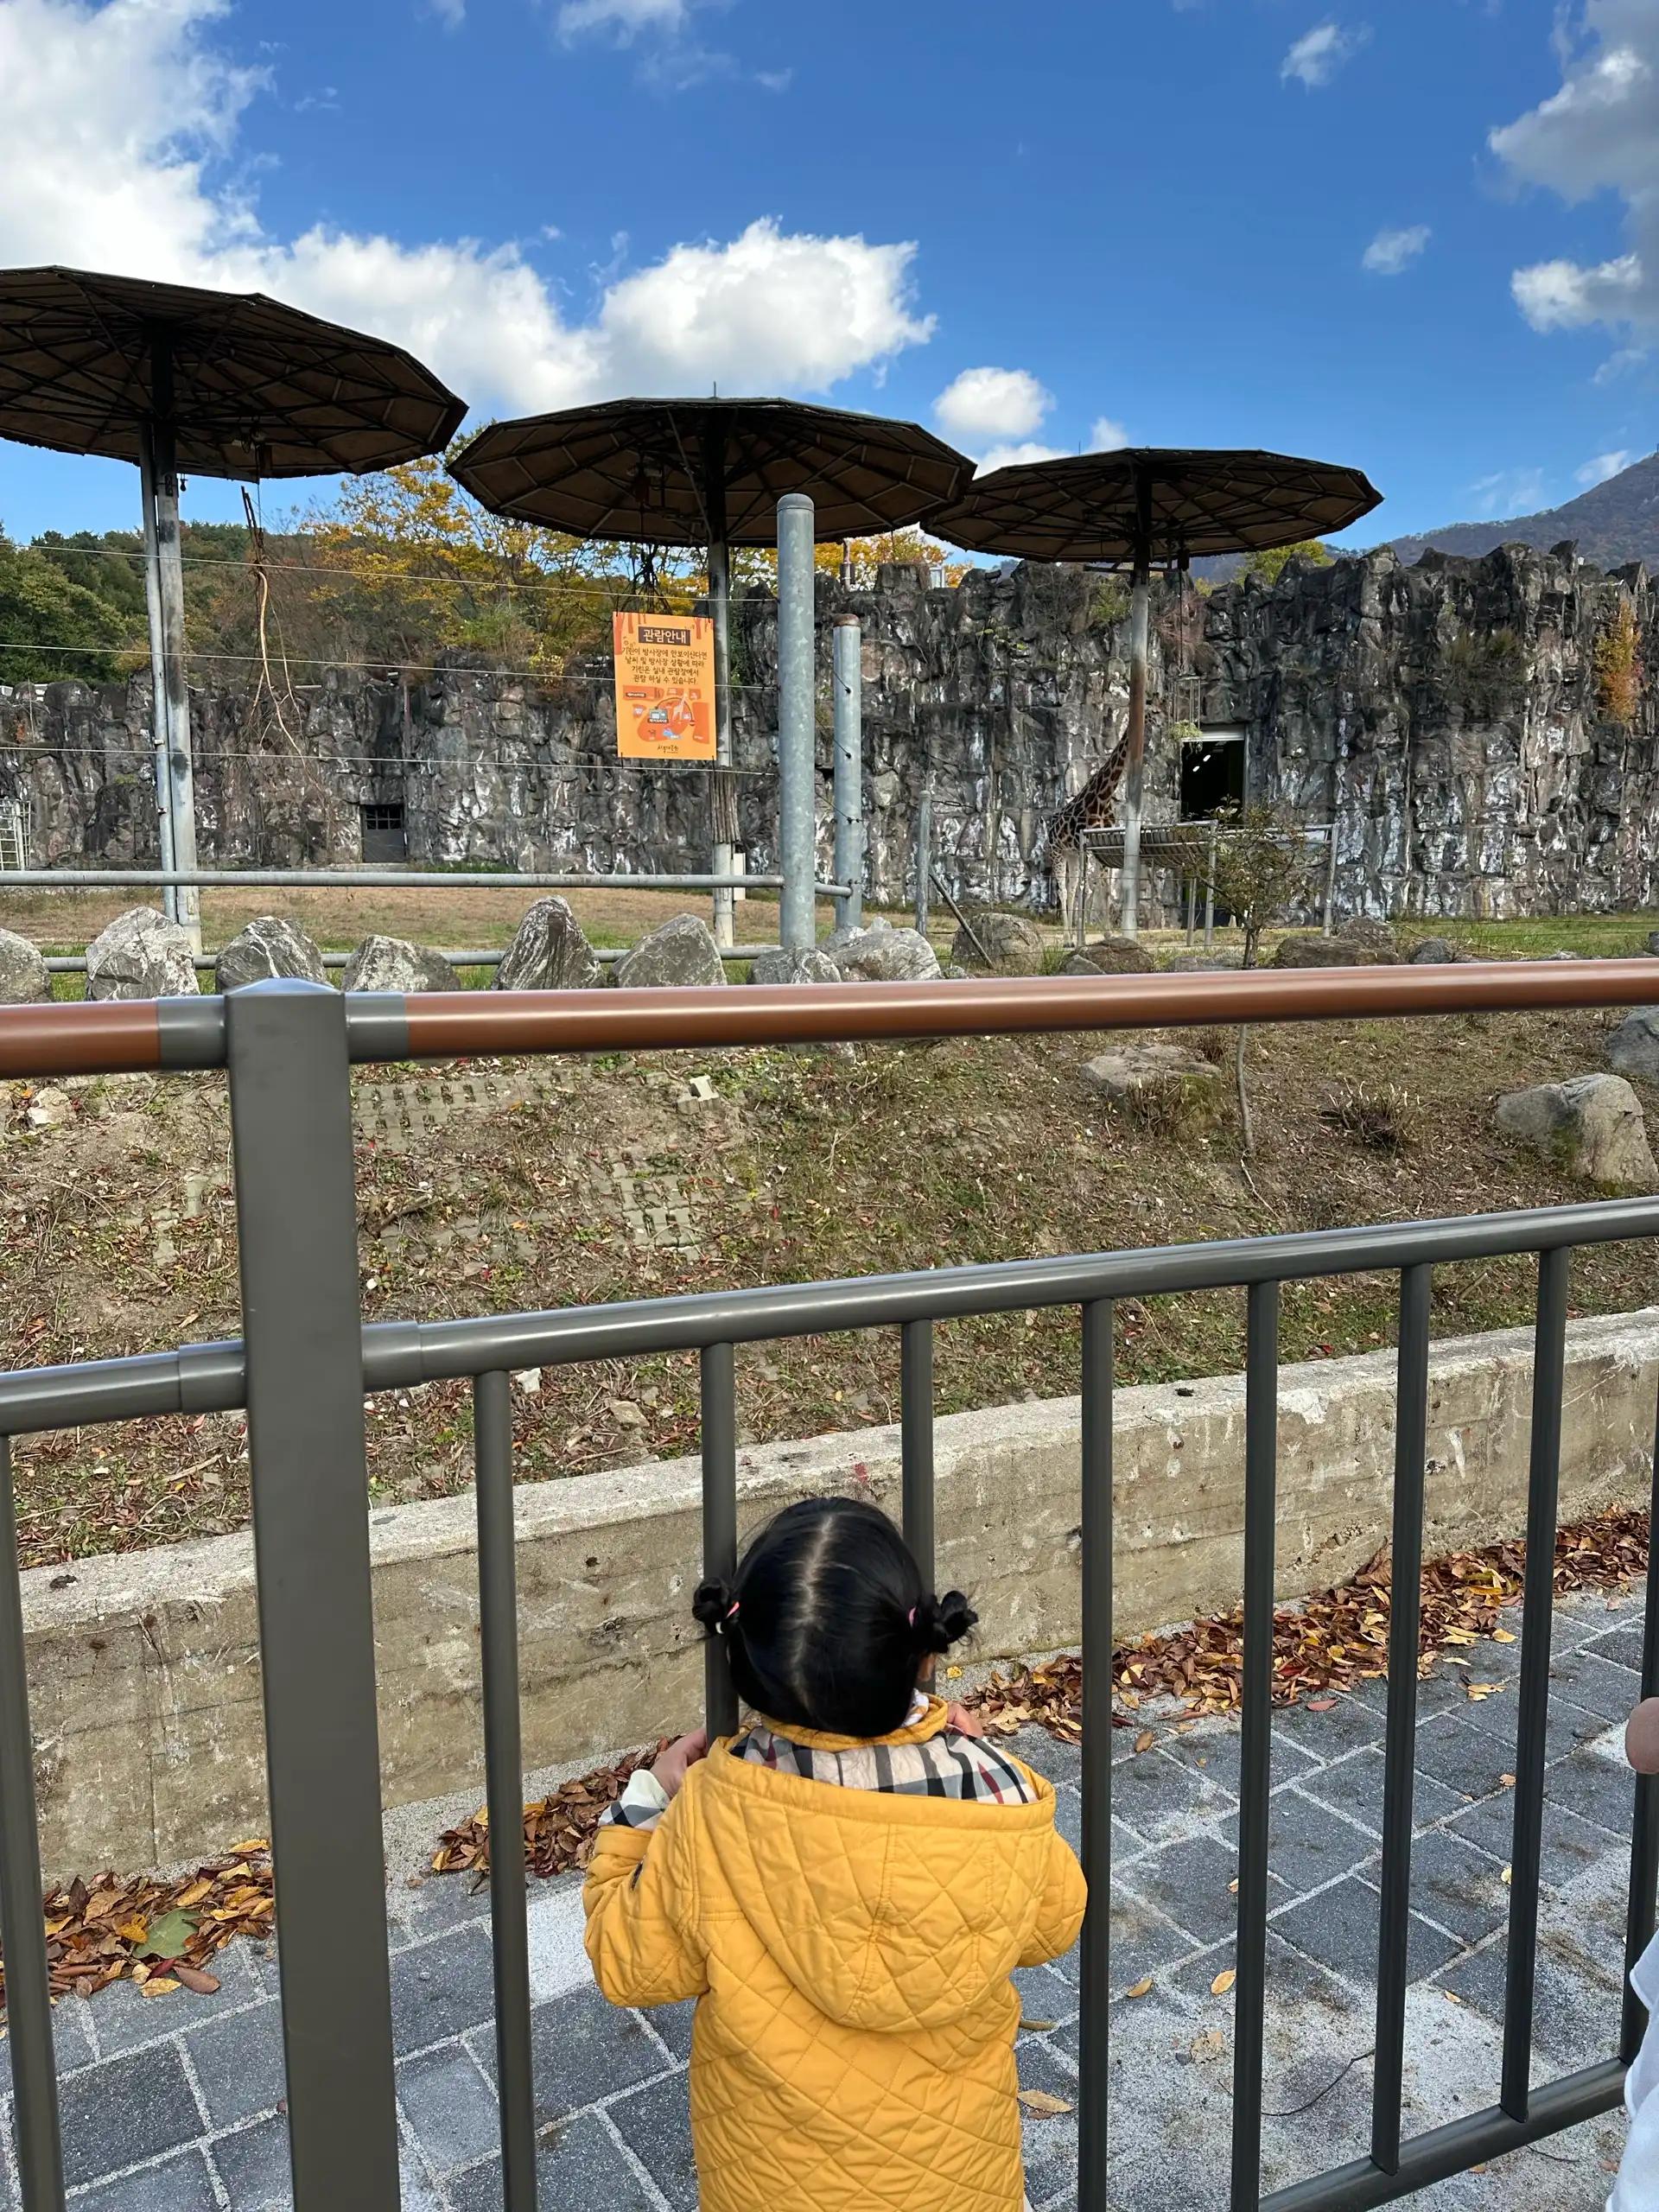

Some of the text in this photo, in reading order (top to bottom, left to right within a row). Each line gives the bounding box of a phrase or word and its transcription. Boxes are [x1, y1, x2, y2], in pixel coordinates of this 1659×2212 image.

[643, 630, 686, 644] 관람안내
[621, 647, 640, 656] 기린이
[642, 649, 669, 658] 방사장에
[625, 656, 639, 664] 날씨
[640, 657, 647, 665] 및
[649, 658, 668, 666] 방사장
[632, 665, 699, 677] 기린은 실내 관람장에서
[633, 674, 646, 683] 관람
[649, 675, 661, 683] 하실
